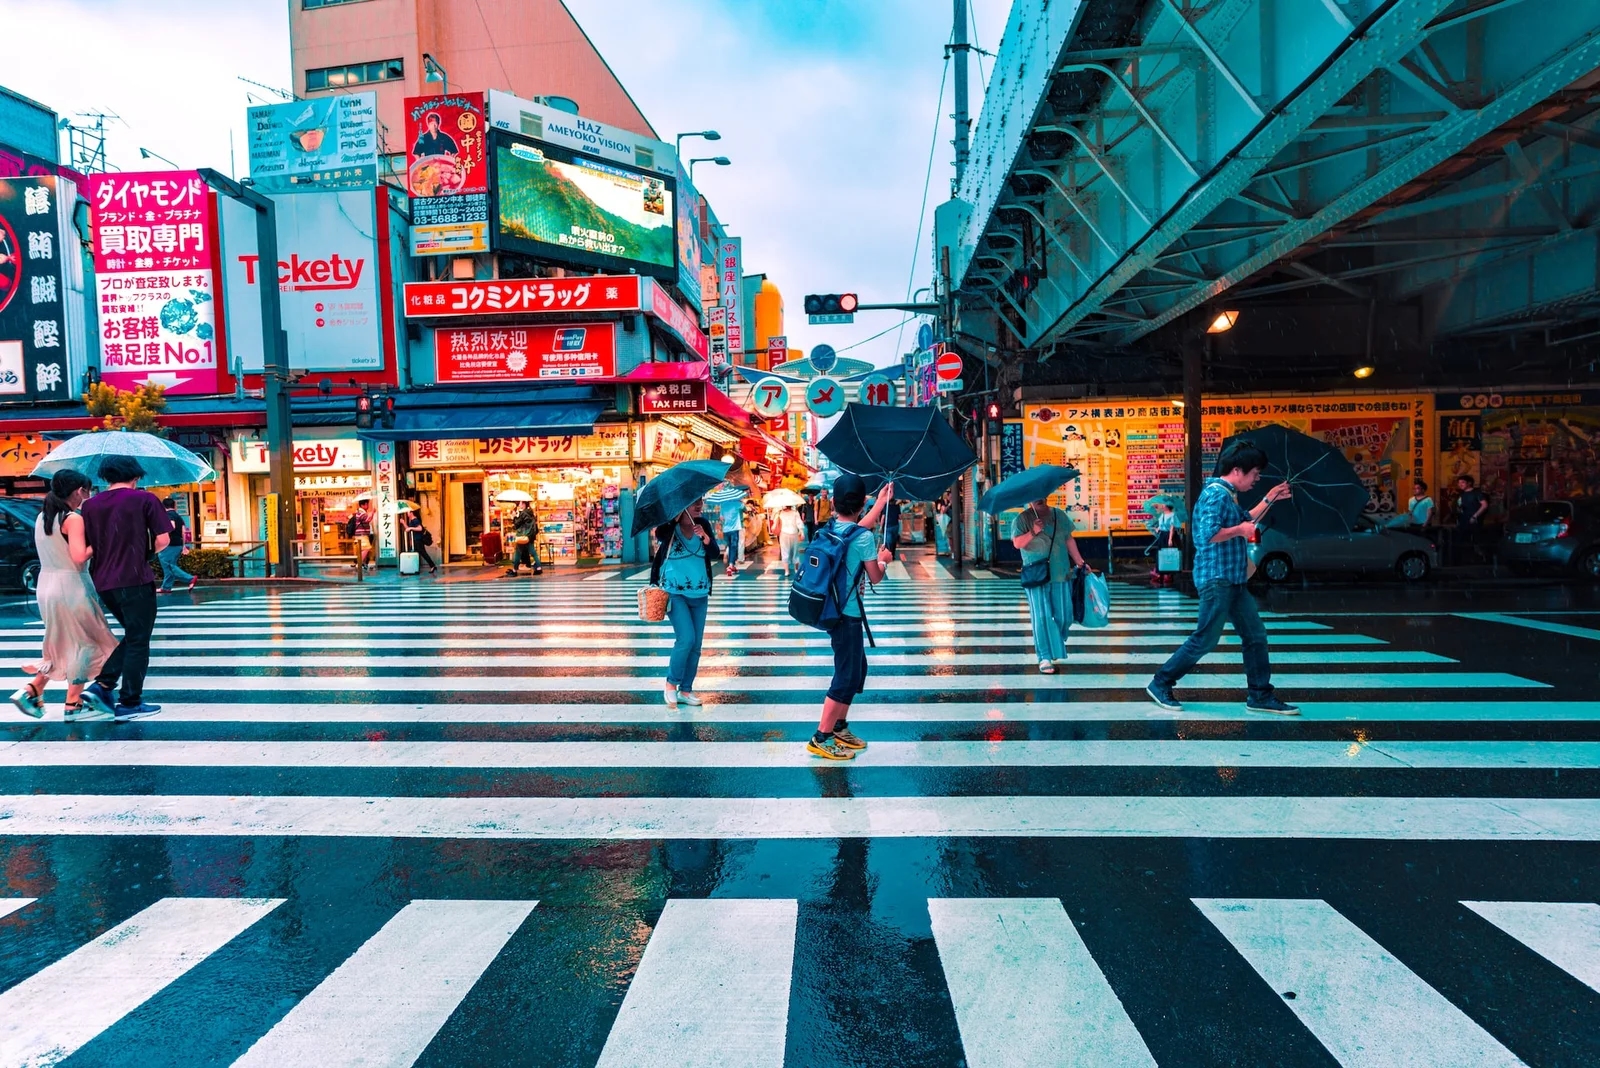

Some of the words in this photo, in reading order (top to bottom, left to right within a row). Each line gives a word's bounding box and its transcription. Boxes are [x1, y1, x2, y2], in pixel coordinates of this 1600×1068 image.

[341, 139, 367, 150] PING
[547, 123, 596, 144] AMEYOKO
[598, 137, 631, 154] VISION
[460, 134, 475, 174] 中本
[96, 178, 202, 209] ダイヤモンド
[98, 209, 202, 223] ブランド・金・プラチナ
[413, 212, 487, 225] 03-5688-1233
[99, 223, 204, 255] 買取専門
[100, 275, 208, 290] プロが査定致します。
[238, 254, 365, 291] Tckety
[410, 294, 446, 306] 化粧品
[451, 282, 591, 310] コクミンドラッグ
[605, 287, 618, 300] 薬
[724, 257, 739, 324] 銀座ハリス
[103, 316, 160, 340] お客様
[450, 330, 529, 353] 热烈欢迎
[651, 400, 671, 408] TAX
[672, 399, 698, 408] FREE
[255, 443, 339, 467] Tkety
[479, 435, 574, 455] コクミンドラッグ
[381, 485, 392, 548] 巨人チケット
